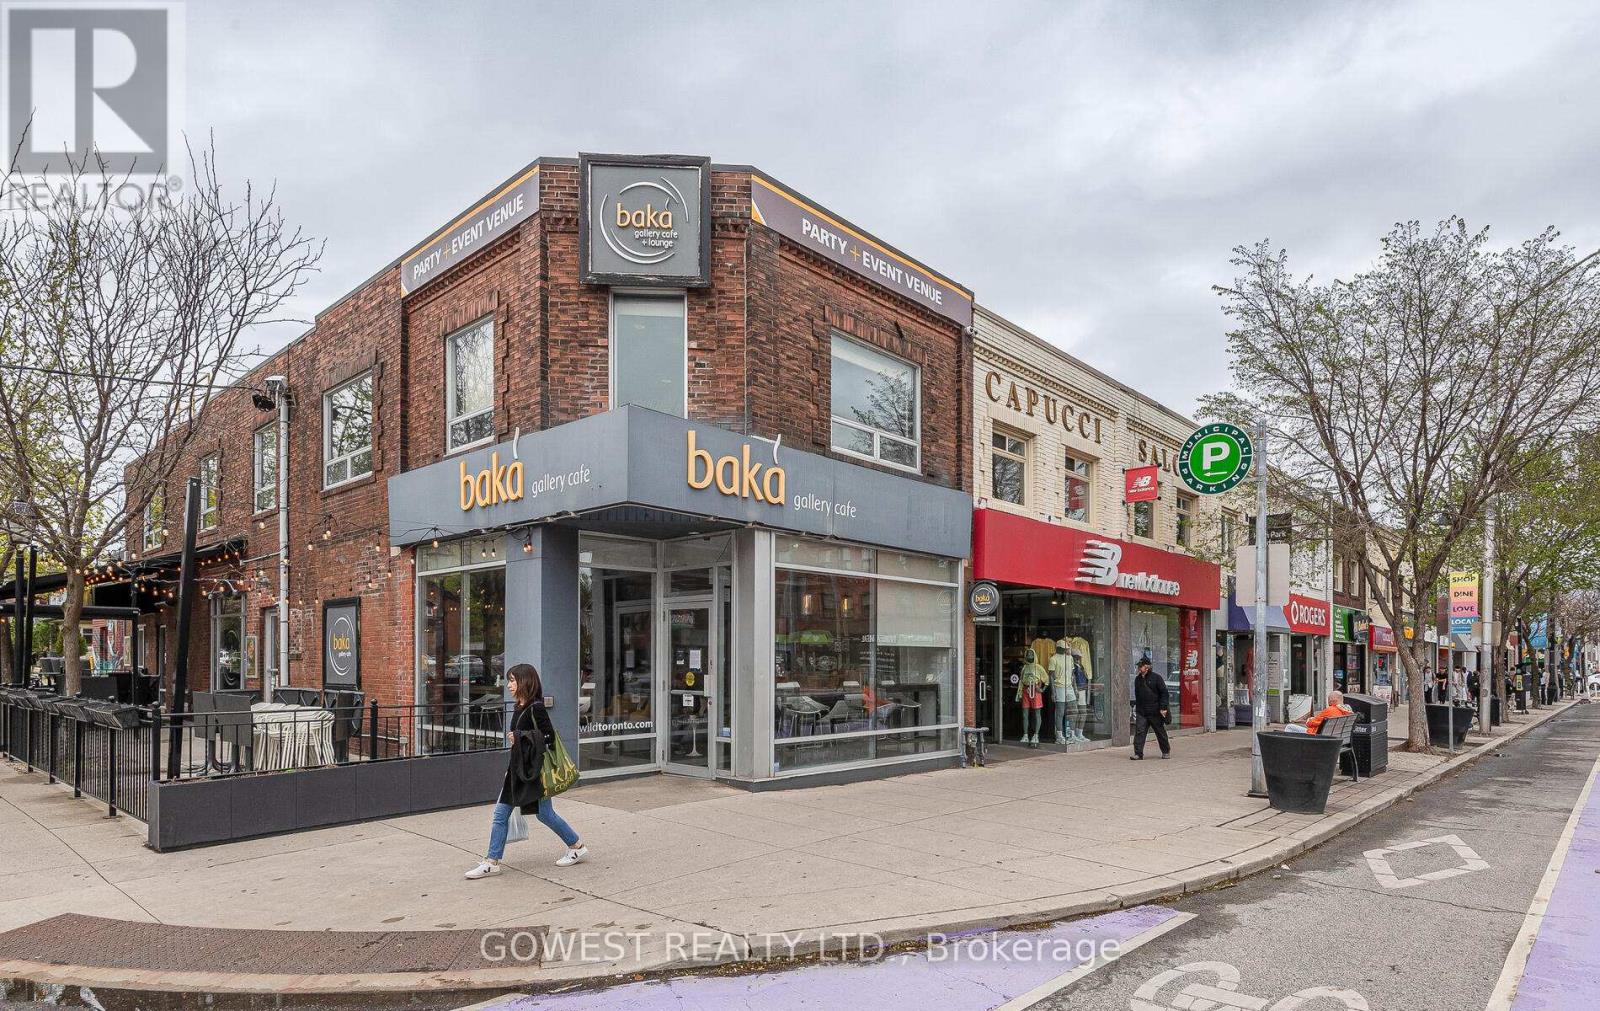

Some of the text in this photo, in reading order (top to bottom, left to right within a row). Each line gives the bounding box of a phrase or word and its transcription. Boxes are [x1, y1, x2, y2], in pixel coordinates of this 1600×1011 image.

[616, 202, 672, 229] baka
[413, 248, 442, 280] PARTY
[451, 220, 485, 255] EVENT
[486, 193, 524, 232] VENUE
[634, 229, 678, 239] gallery cafe
[802, 218, 848, 255] PARTY
[862, 250, 903, 284] EVENT
[905, 272, 943, 305] VENUE
[985, 371, 1102, 444] CAPUCCI
[1182, 426, 1249, 459] MUNICIPAL
[1202, 441, 1231, 471] P
[459, 451, 591, 512] baka gallery cafe
[687, 430, 857, 518] baka gallery cafe
[1181, 463, 1248, 492] PARKING
[1270, 530, 1287, 538] Park
[1299, 604, 1326, 627] ROGERS
[333, 633, 350, 650] baka
[579, 720, 654, 733] wildtoronto.com
